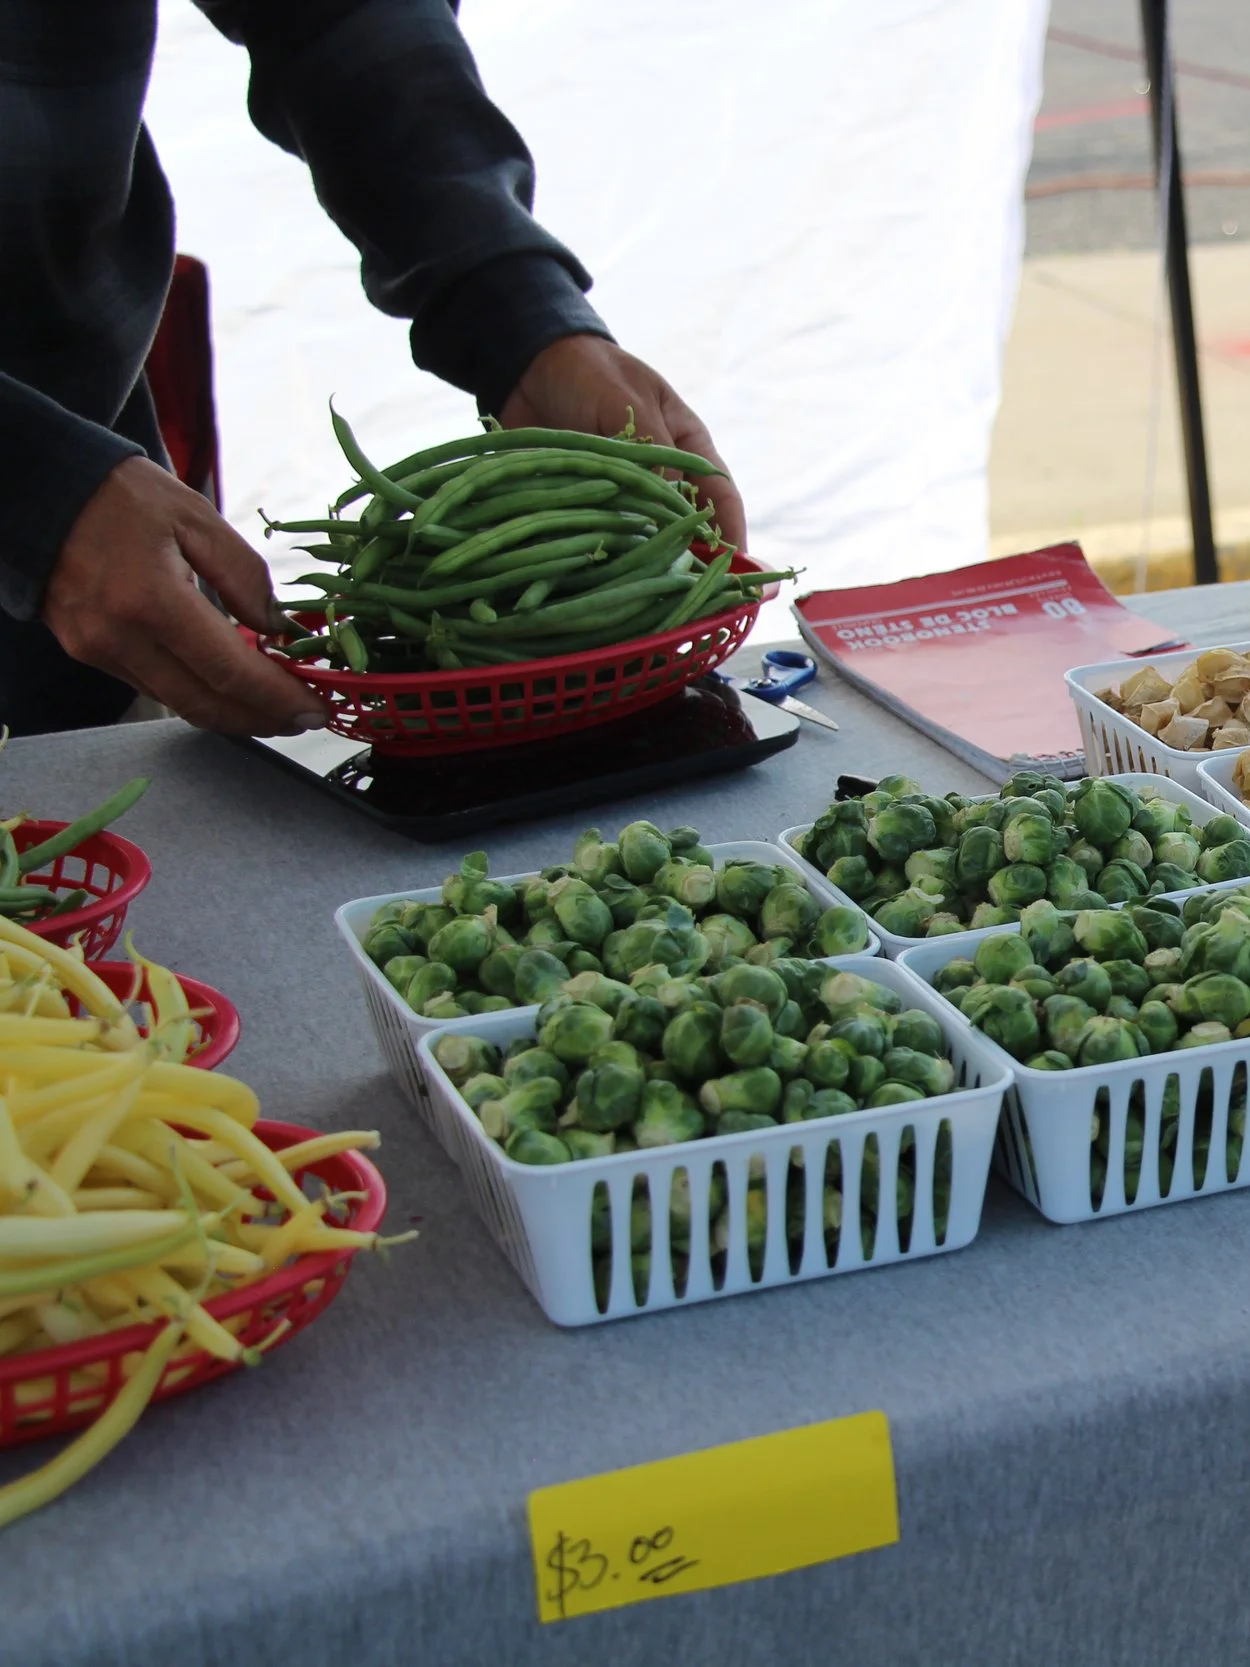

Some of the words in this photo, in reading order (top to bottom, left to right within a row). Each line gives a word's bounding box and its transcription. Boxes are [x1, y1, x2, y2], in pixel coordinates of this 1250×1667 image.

[919, 613, 951, 628] DE
[956, 603, 1018, 623] BLOC
[847, 618, 992, 651] STENOBOOK
